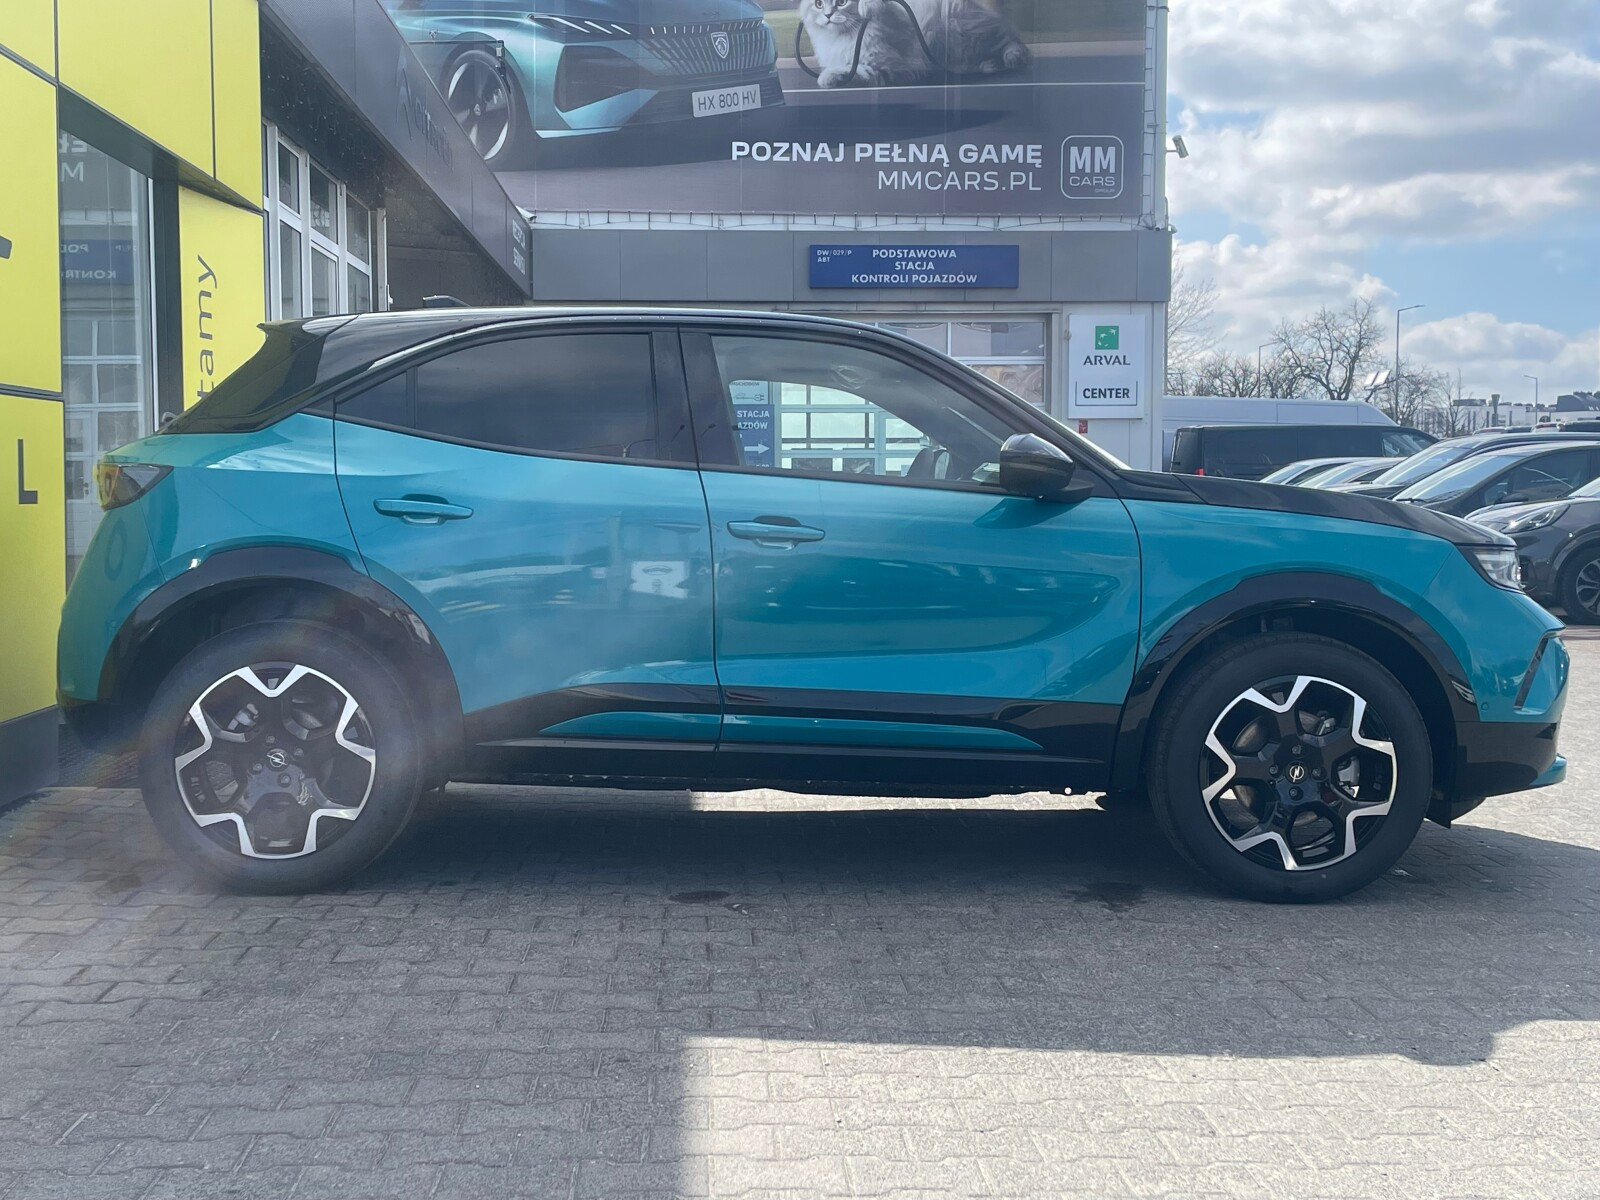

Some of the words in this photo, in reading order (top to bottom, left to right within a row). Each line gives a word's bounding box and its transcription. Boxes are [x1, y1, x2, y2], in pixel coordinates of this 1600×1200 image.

[698, 95, 715, 111] HX
[719, 92, 739, 108] 800
[742, 90, 756, 105] HV
[731, 141, 845, 162] POZNAJ
[854, 143, 950, 168] PEŁNĄ
[958, 144, 1042, 168] GAMĘ
[1069, 146, 1116, 173] MM
[878, 170, 1042, 191] MMCARS.PL
[1069, 176, 1115, 187] CARS
[872, 249, 957, 258] PODSTAWOWA
[895, 261, 934, 270] STACJA
[851, 274, 908, 283] KONTROLI
[912, 272, 977, 283] POJAZDÓW
[1083, 355, 1131, 366] ARVAL
[1082, 387, 1130, 399] CENTER
[736, 410, 770, 418] STACJA
